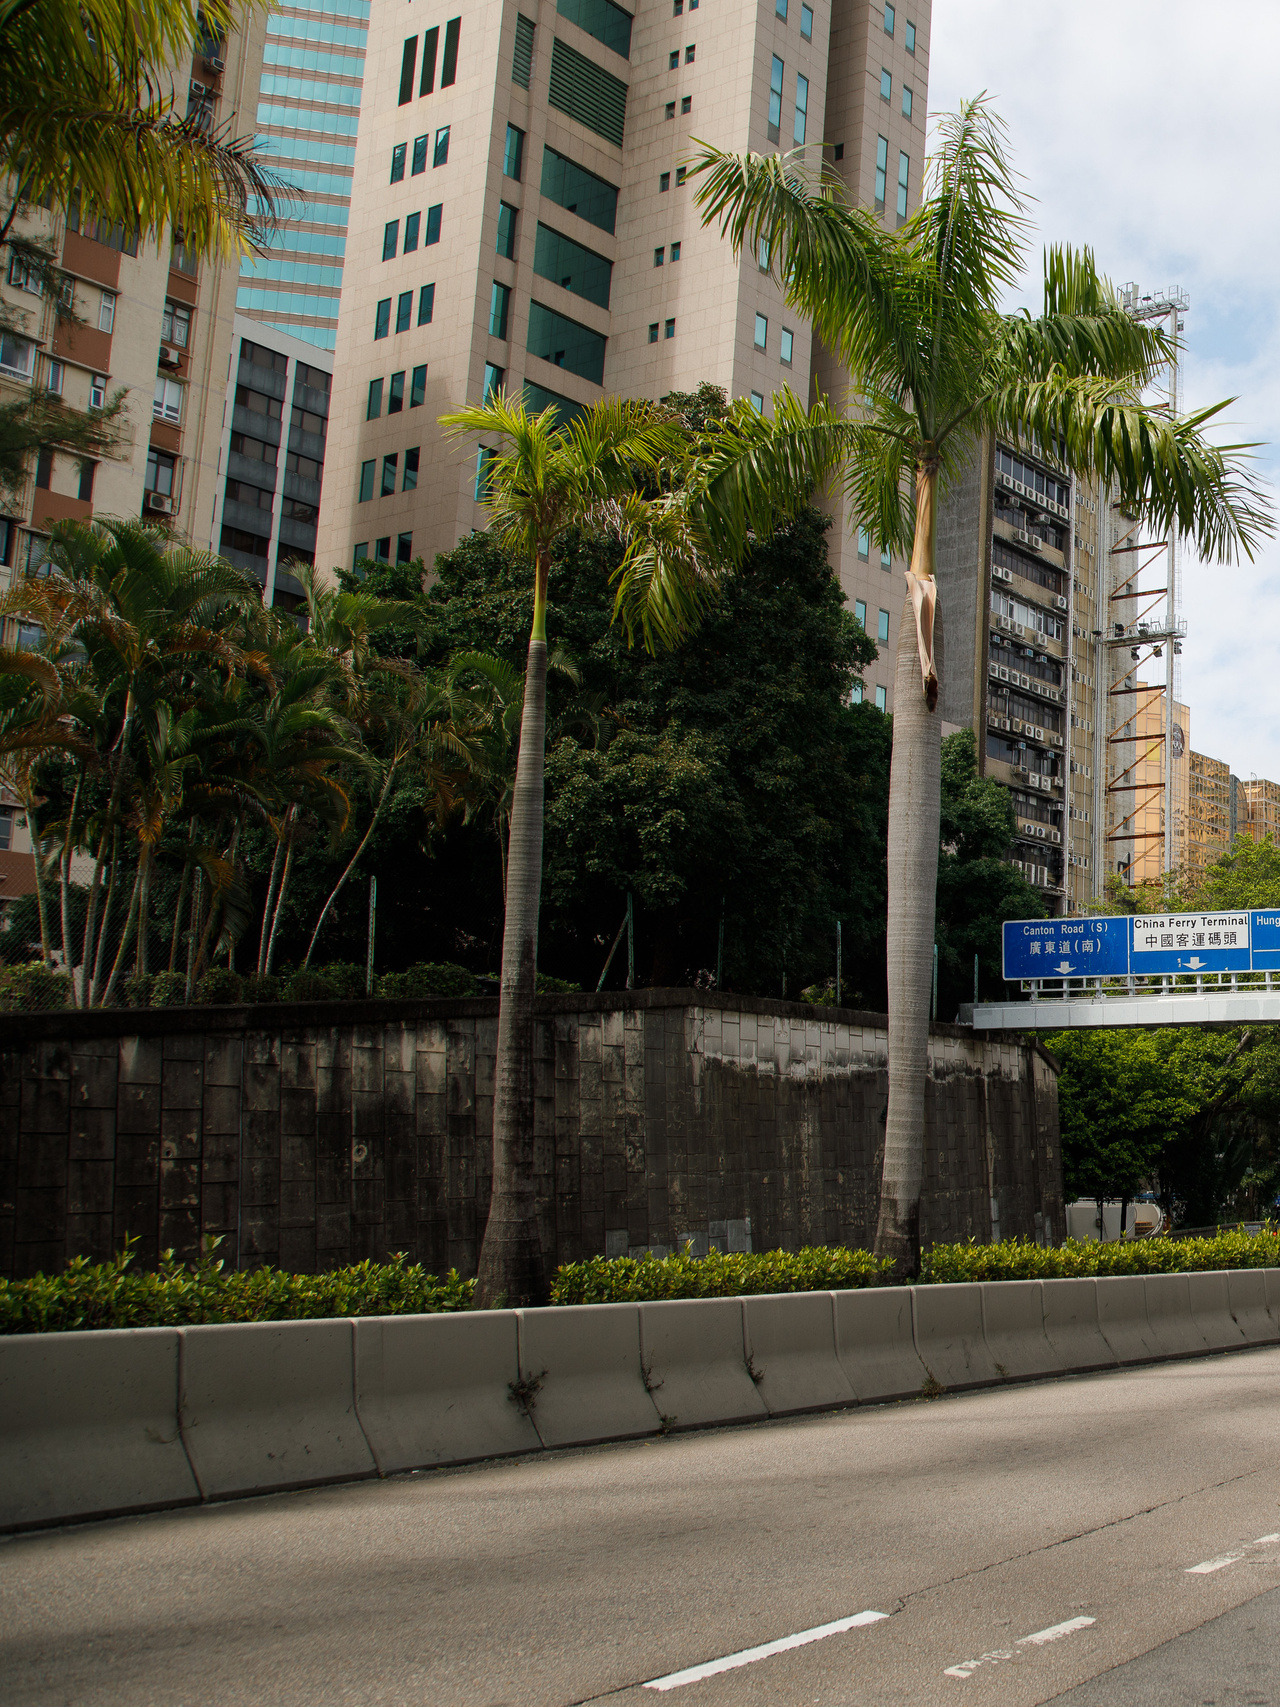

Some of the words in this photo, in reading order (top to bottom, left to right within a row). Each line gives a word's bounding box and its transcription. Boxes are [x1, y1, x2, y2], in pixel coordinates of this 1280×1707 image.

[1134, 918, 1165, 929] China
[1168, 917, 1197, 930] Ferry
[1200, 916, 1248, 927] Terminal
[1256, 915, 1280, 928] Hung
[1023, 925, 1055, 936] Canton
[1060, 923, 1084, 934] Road
[1090, 922, 1109, 934] (S)
[1029, 937, 1102, 955] 廣東道(南)
[1145, 931, 1238, 949] 中國客運碼頭
